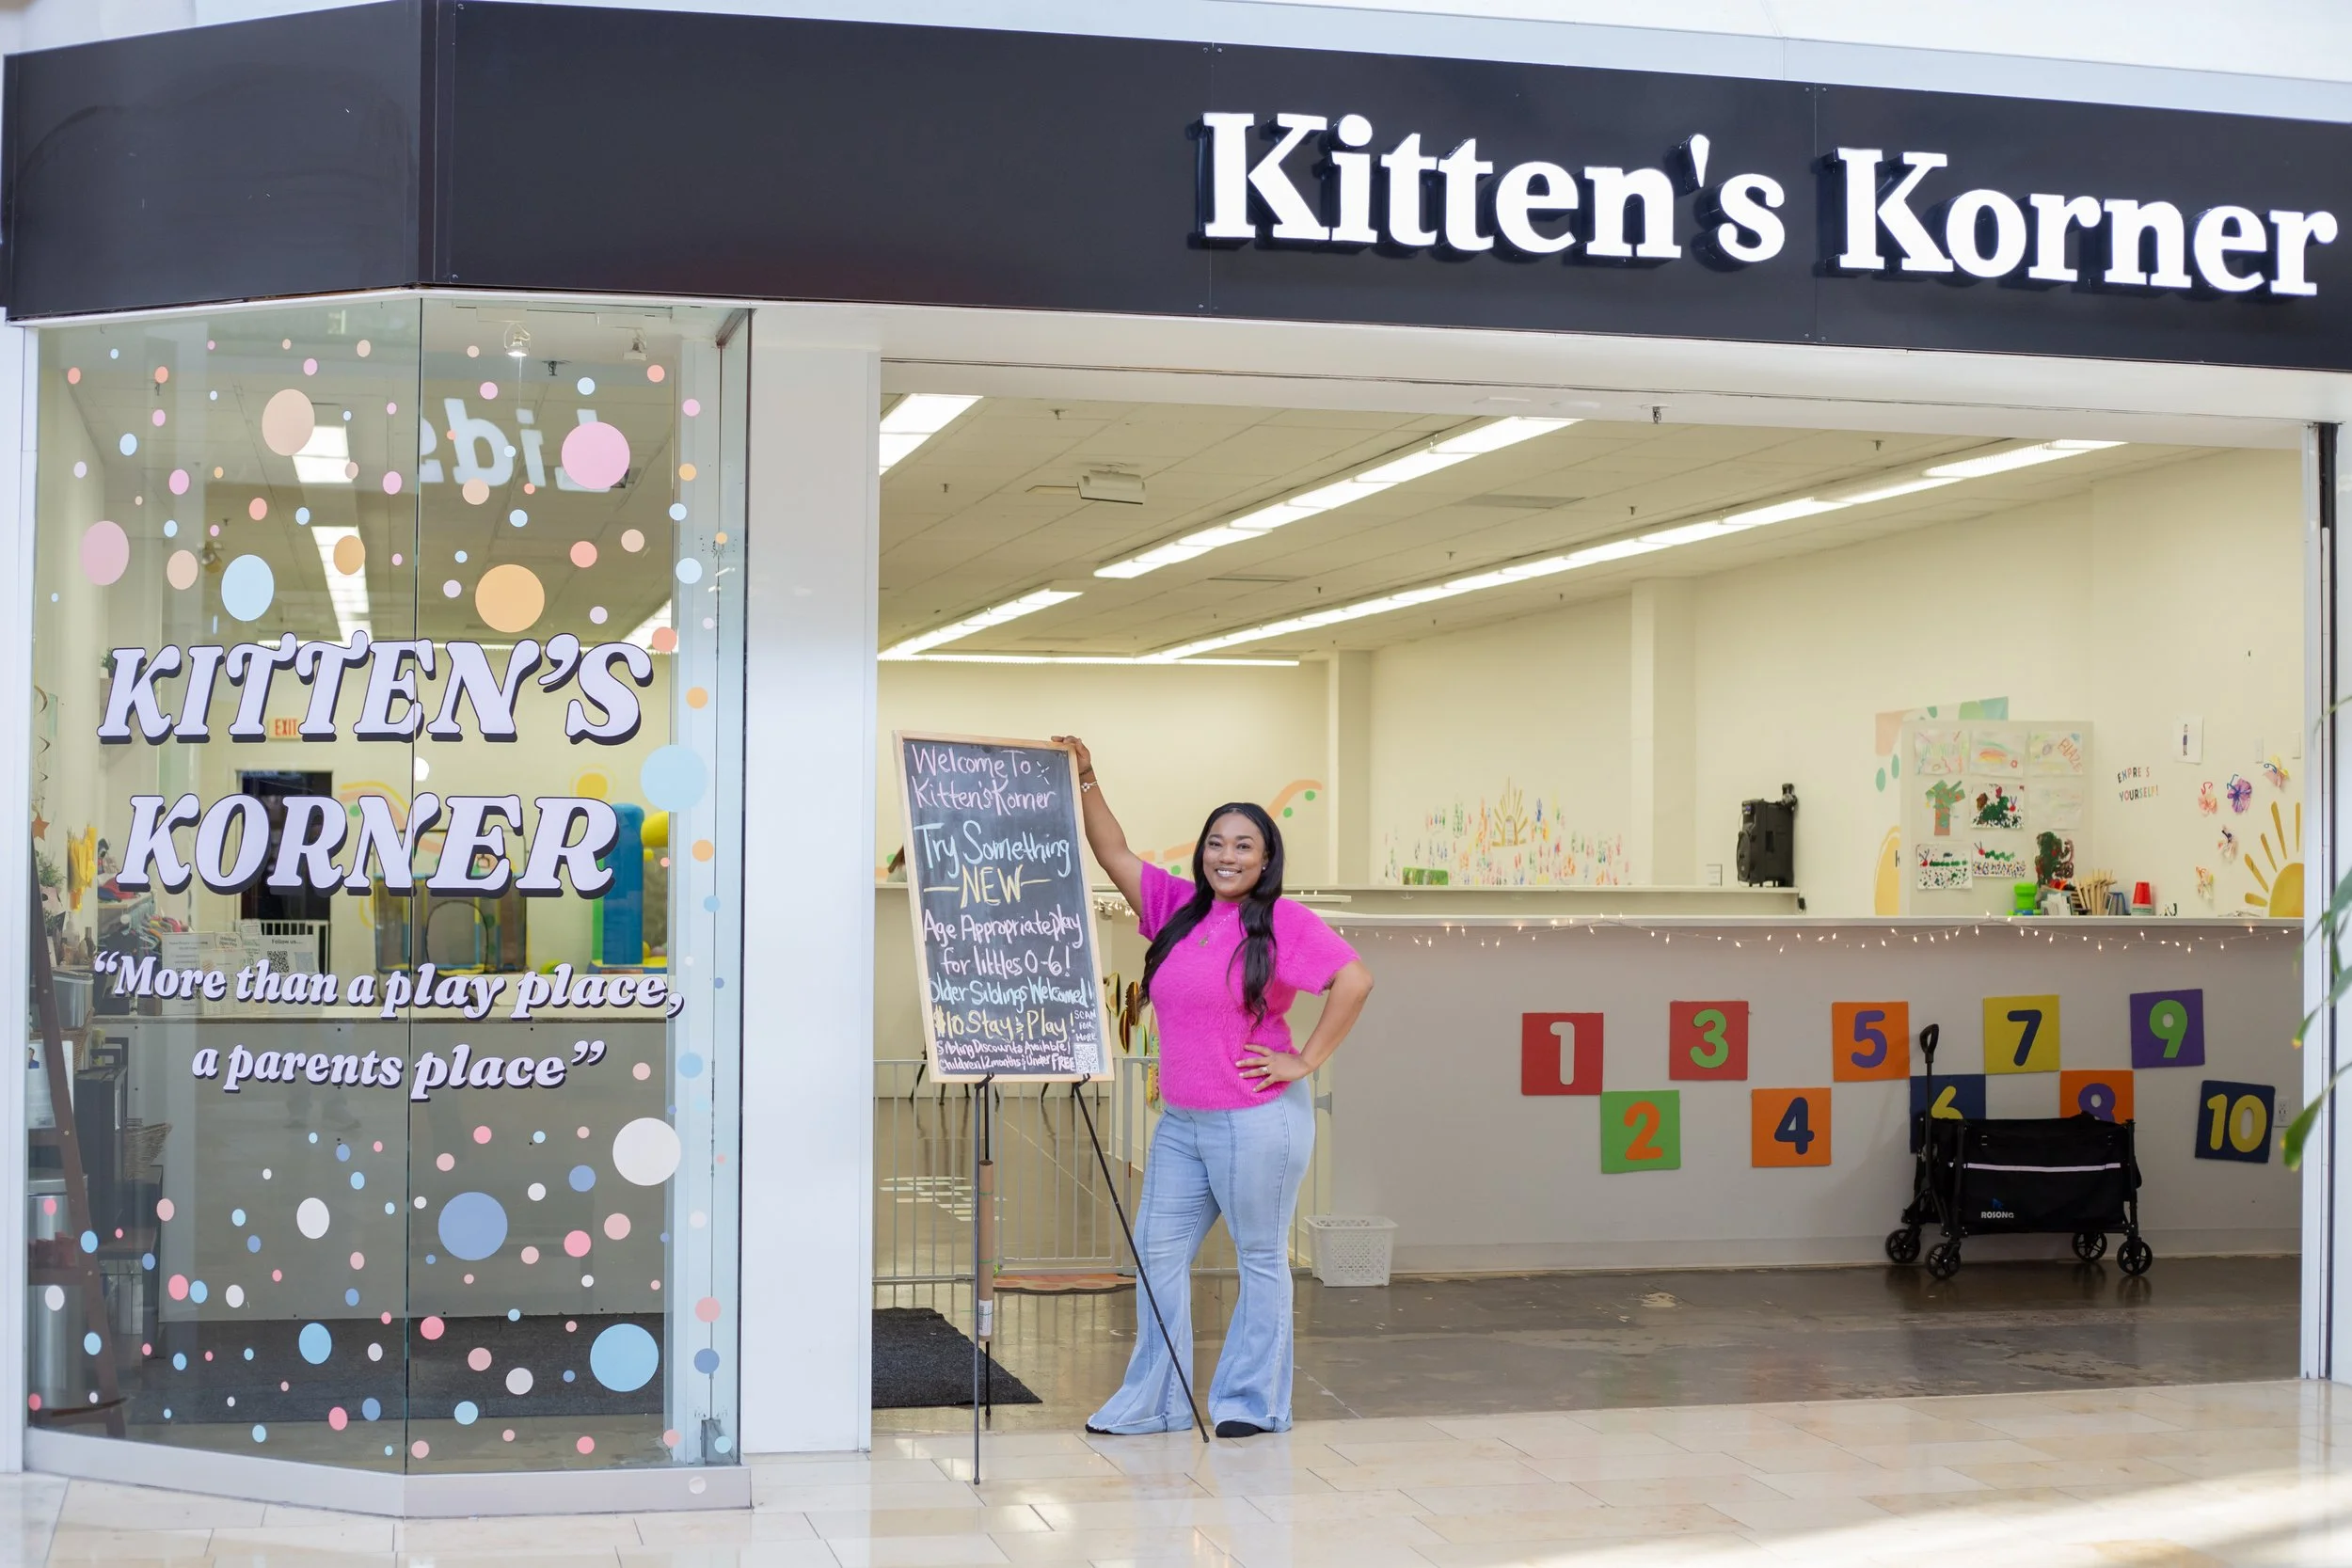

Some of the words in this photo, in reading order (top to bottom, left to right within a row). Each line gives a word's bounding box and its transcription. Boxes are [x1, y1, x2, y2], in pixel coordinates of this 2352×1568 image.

[1200, 110, 1786, 264] Kitten's
[1836, 146, 2339, 298] Korner
[96, 629, 655, 746] KITTEN’S
[275, 719, 298, 736] EXIT
[911, 744, 1009, 779] Welcome
[1000, 750, 1032, 778] To
[992, 779, 1057, 816] Korner
[2119, 784, 2159, 802] YOURSELF!
[116, 791, 620, 898] KORNER
[914, 822, 961, 879] Try
[961, 820, 1072, 878] Something
[923, 909, 958, 947] Age
[973, 945, 1024, 979] littles
[235, 958, 339, 1007] than
[347, 973, 377, 1006] a
[380, 962, 506, 1021] play
[511, 962, 686, 1020] place,
[929, 973, 969, 1006] Older
[967, 980, 1029, 1013] Siblings
[1073, 1008, 1097, 1021] SCAN
[932, 1005, 964, 1039] $10
[966, 1008, 1014, 1042] Stay
[1075, 1032, 1098, 1042] MORE
[1078, 1022, 1095, 1030] FOR
[1689, 1009, 1730, 1069] 3
[1850, 1010, 1887, 1069] 5
[2007, 1009, 2042, 1067] 7
[2149, 999, 2189, 1059] 9
[192, 1044, 219, 1079] a
[224, 1043, 405, 1094] parents
[1051, 1051, 1076, 1071] FREE
[1549, 1022, 1575, 1085] 1
[1623, 1101, 1664, 1161] 2
[1773, 1097, 1815, 1156] 4
[2206, 1094, 2265, 1152] 10
[1980, 1211, 2014, 1219] ROSONG
